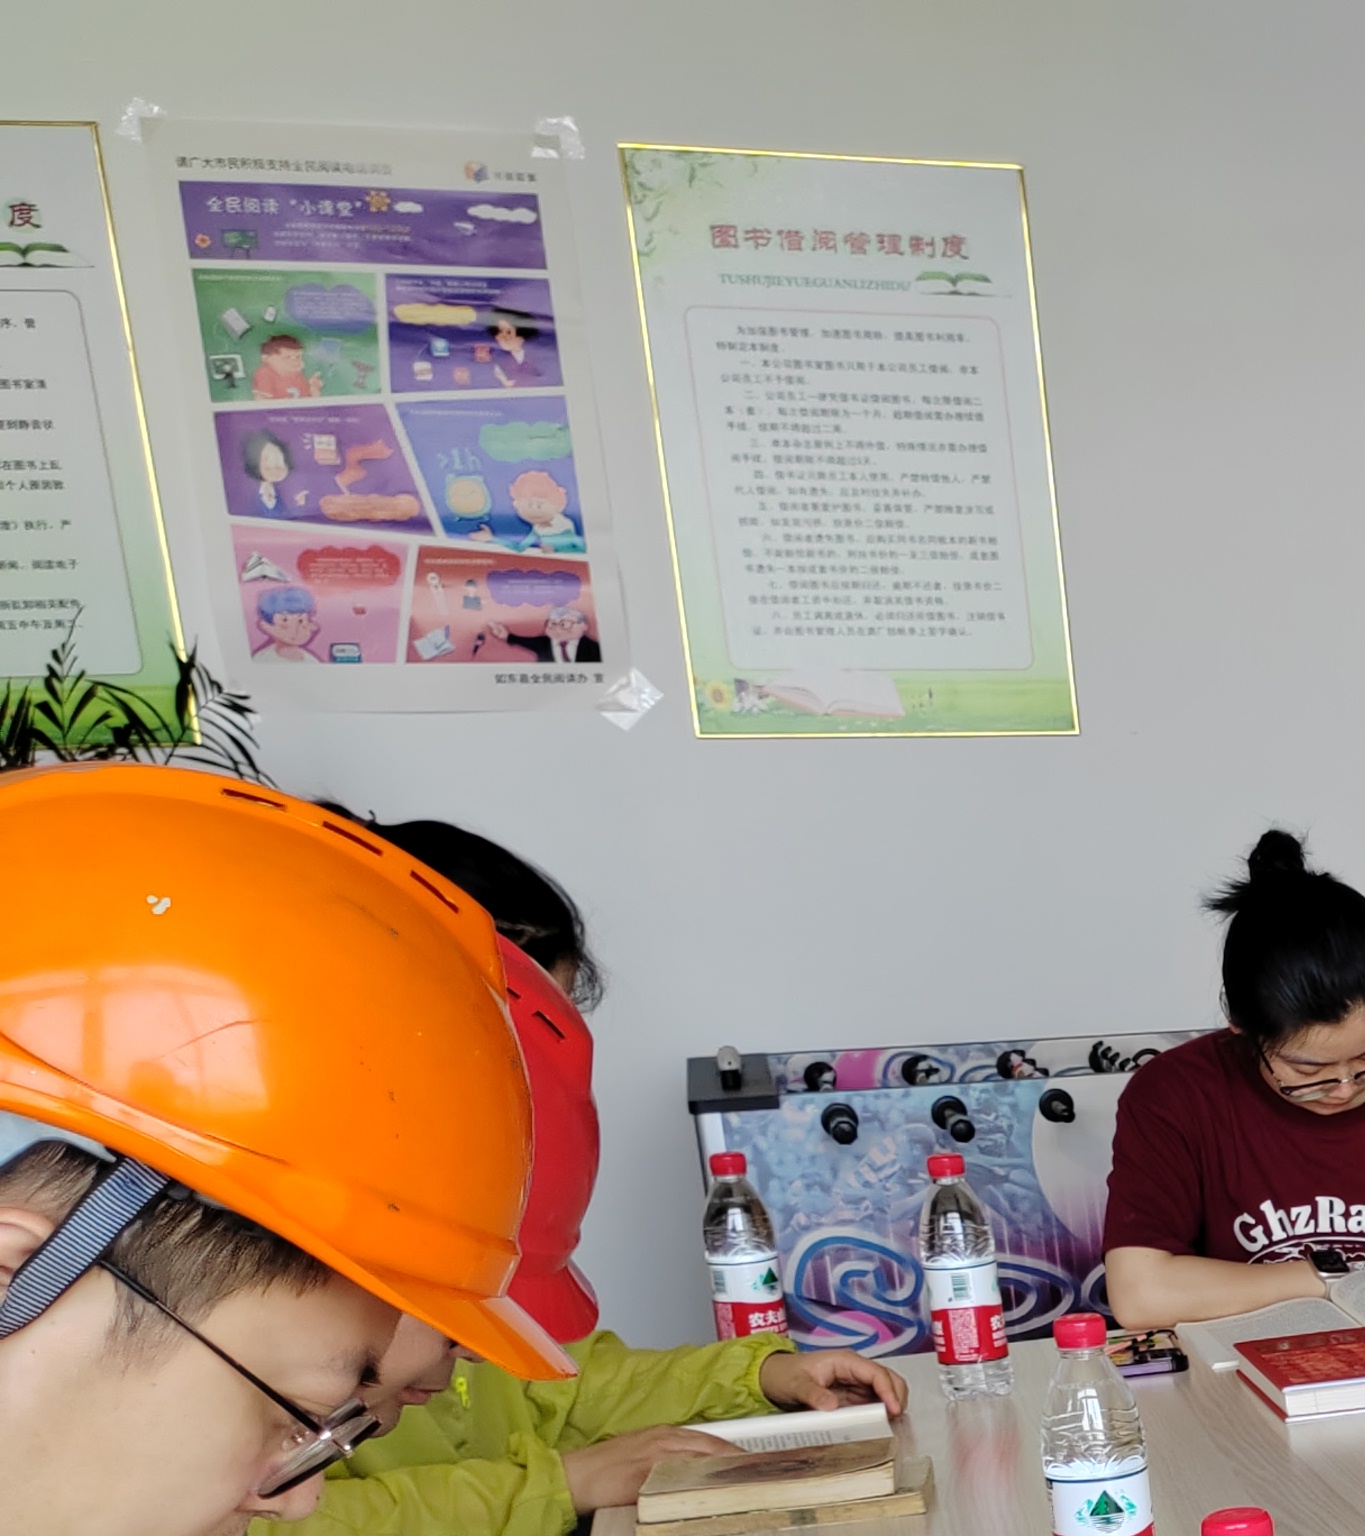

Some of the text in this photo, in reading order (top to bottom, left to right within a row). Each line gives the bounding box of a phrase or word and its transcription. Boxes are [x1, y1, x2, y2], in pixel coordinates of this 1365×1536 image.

[9, 202, 41, 229] 度
[206, 196, 280, 215] 全民阅读
[709, 223, 970, 260] 图书借阅管理制度
